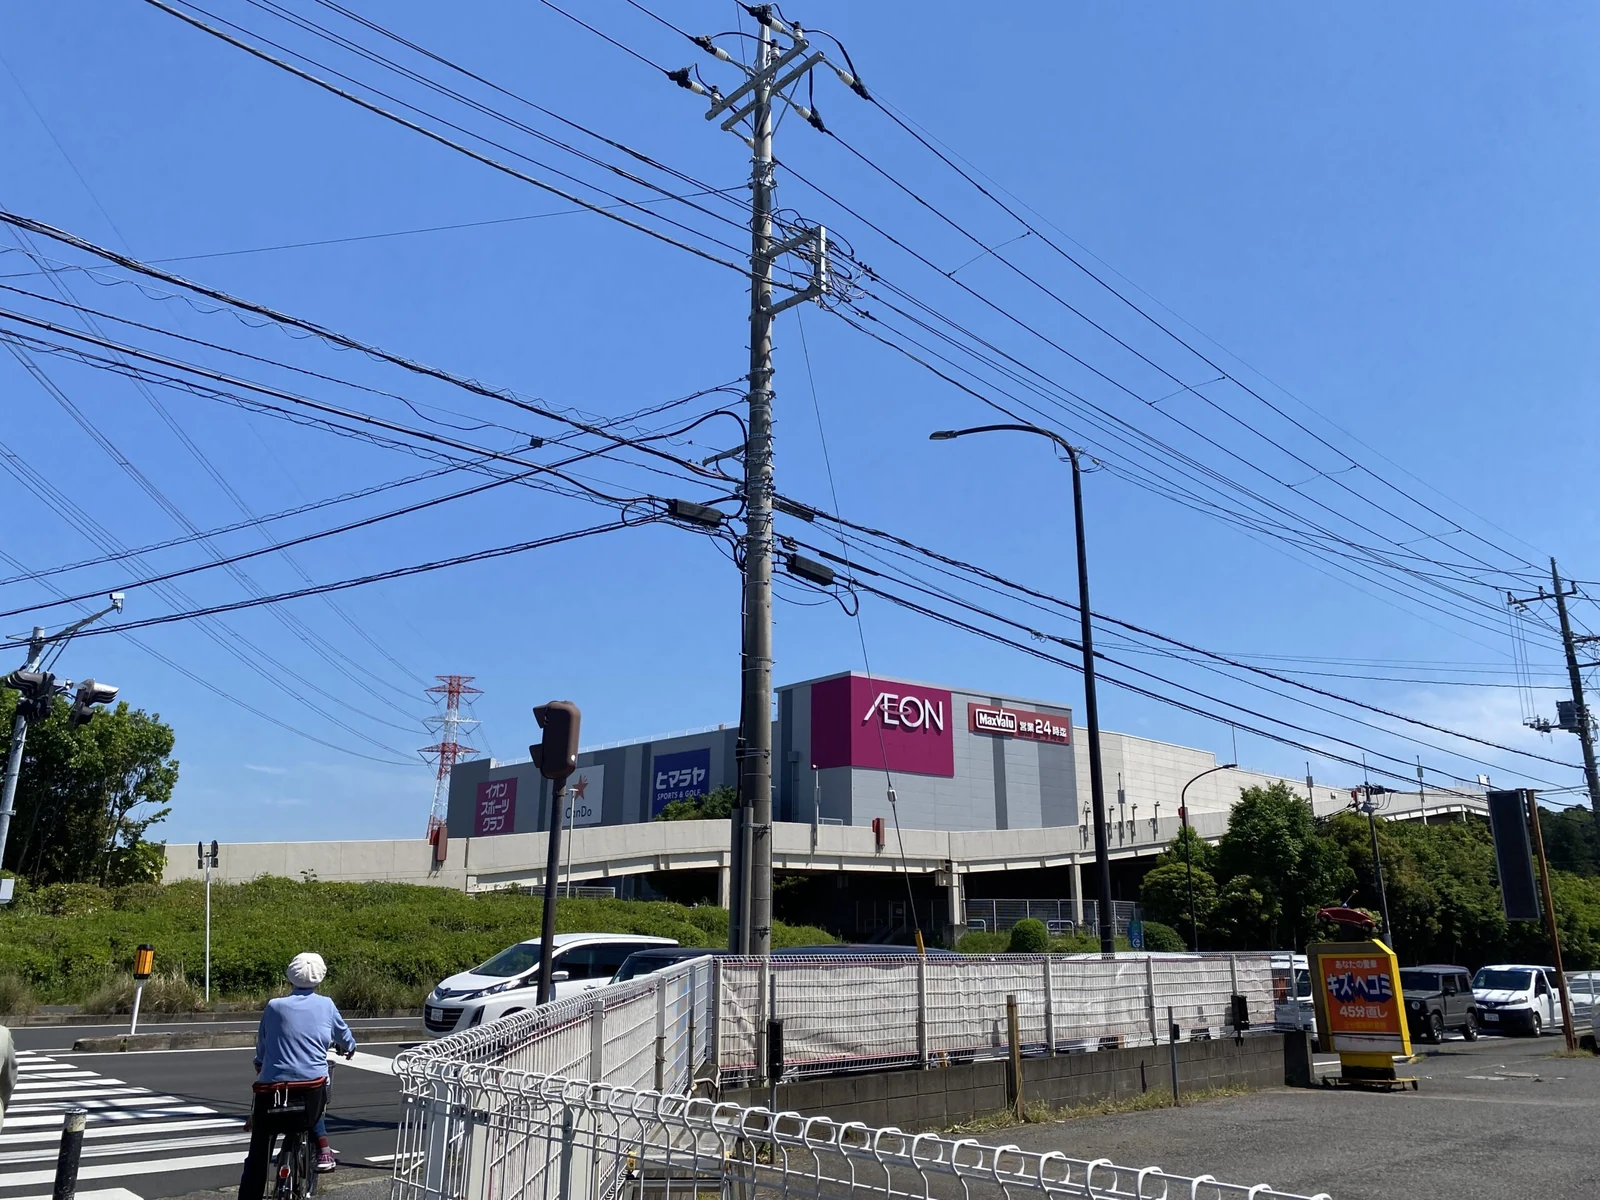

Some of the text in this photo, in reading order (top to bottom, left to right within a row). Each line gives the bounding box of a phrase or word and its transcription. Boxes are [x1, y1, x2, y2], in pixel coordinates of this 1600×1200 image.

[979, 709, 1014, 729] MaxValu
[656, 767, 706, 790] ヒマラヤ
[485, 783, 508, 799] イオン
[657, 791, 678, 801] SPORTS
[685, 789, 701, 798] GOLF
[481, 799, 510, 816] スポーツ
[482, 815, 505, 832] クラブ
[1340, 1005, 1388, 1018] 45分直し
